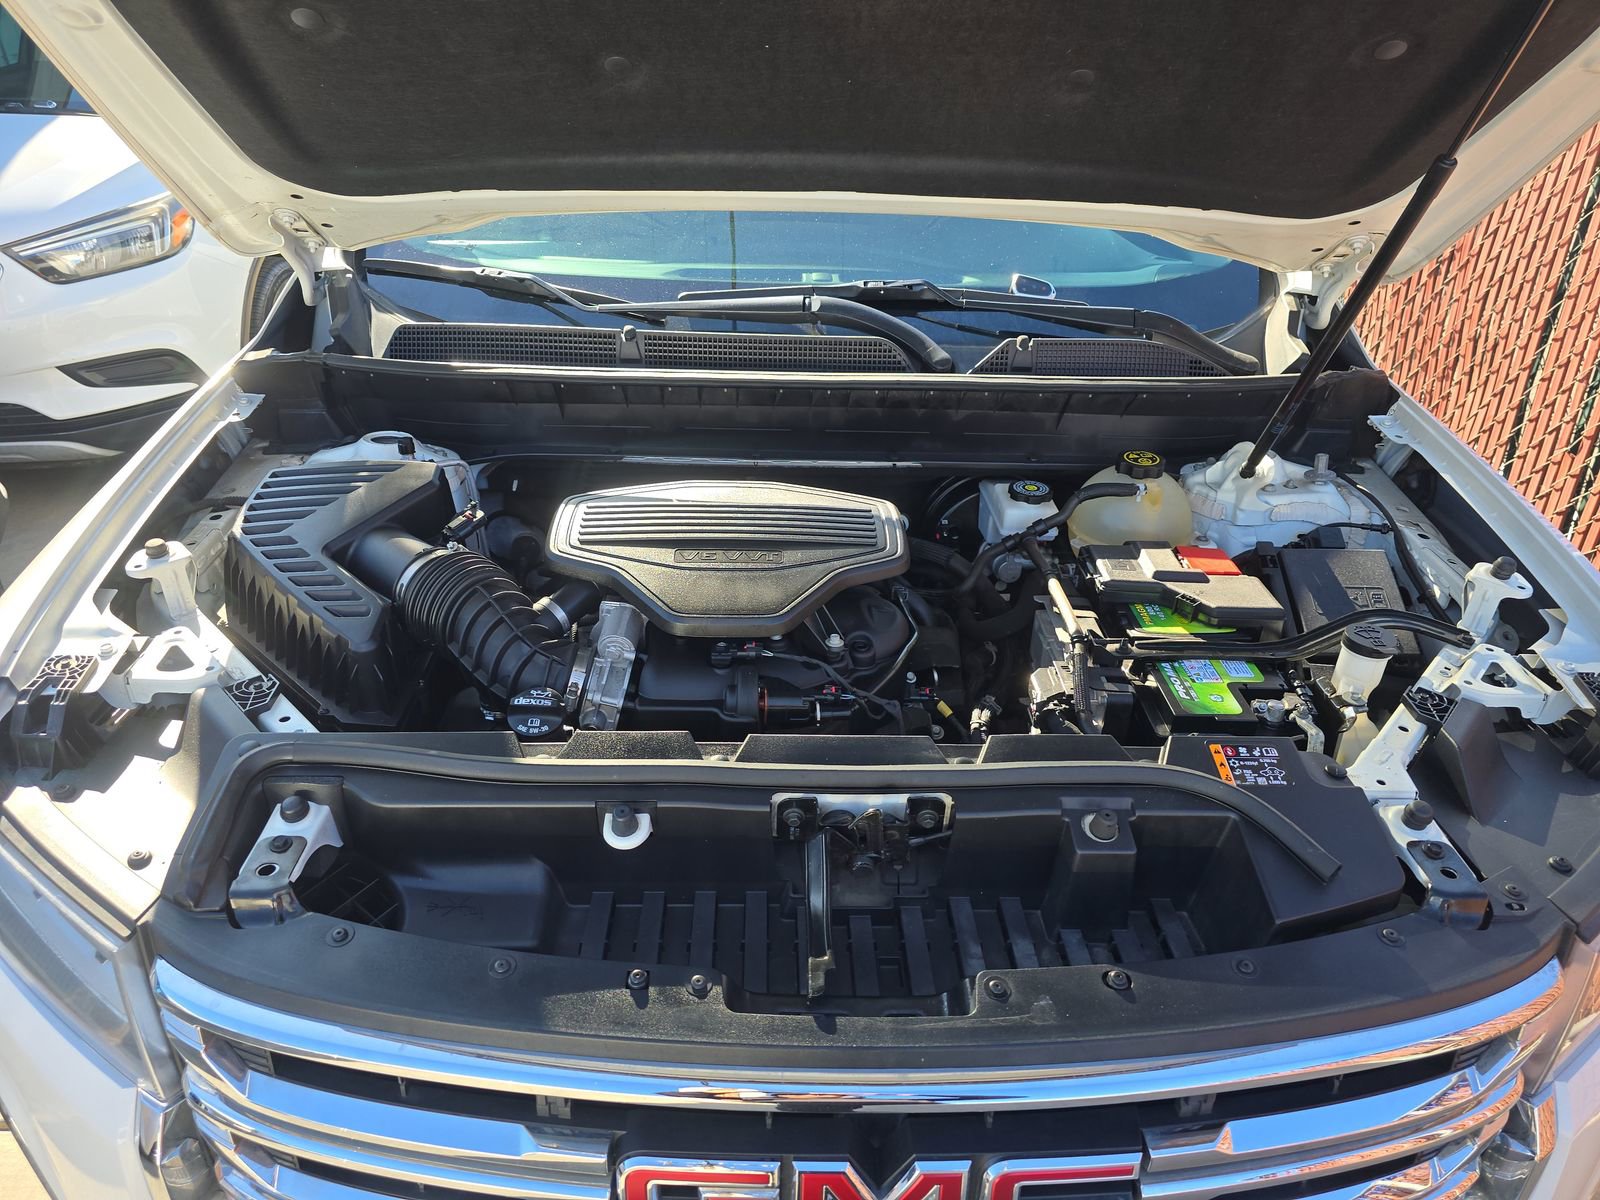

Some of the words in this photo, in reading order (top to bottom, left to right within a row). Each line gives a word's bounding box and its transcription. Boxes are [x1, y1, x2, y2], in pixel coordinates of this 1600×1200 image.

[678, 551, 717, 561] V6
[722, 551, 780, 562] VVT
[513, 696, 553, 706] dexos
[516, 724, 529, 733] SAE
[528, 724, 549, 734] 5W-30
